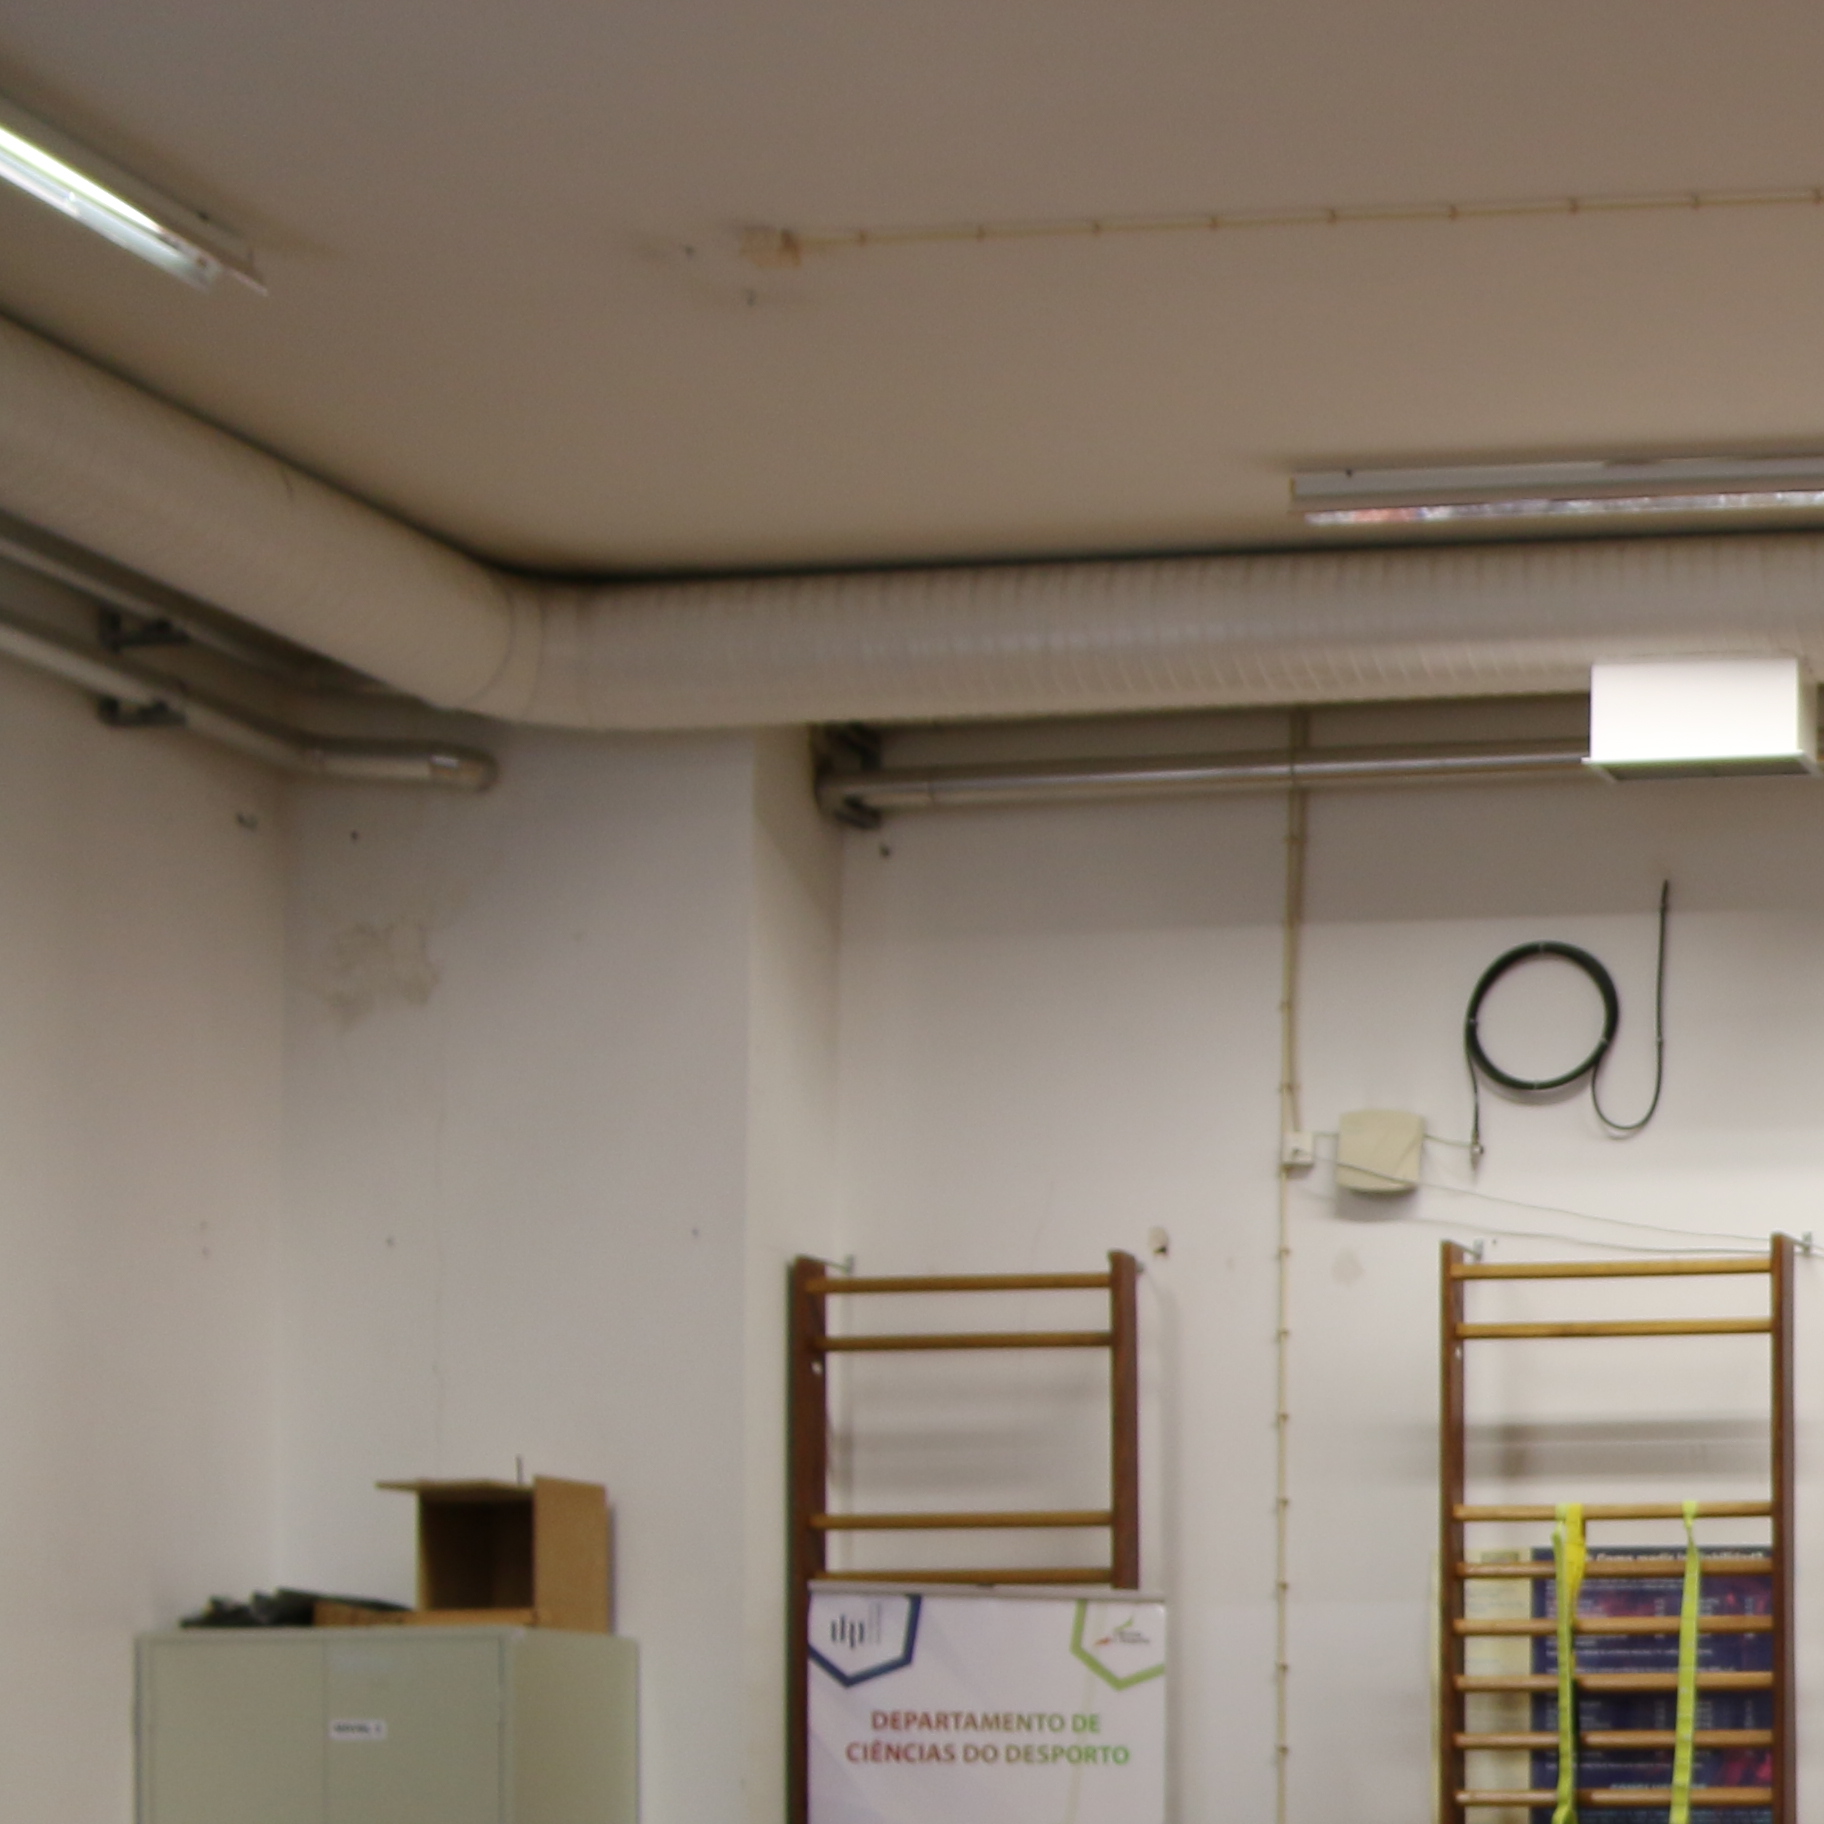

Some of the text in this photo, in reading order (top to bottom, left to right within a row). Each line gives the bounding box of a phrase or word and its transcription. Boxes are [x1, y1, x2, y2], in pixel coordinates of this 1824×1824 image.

[870, 1710, 1100, 1734] DEPARTAMENTO DE
[845, 1739, 1131, 1766] CIÊNCIAS DO DESPORTO
